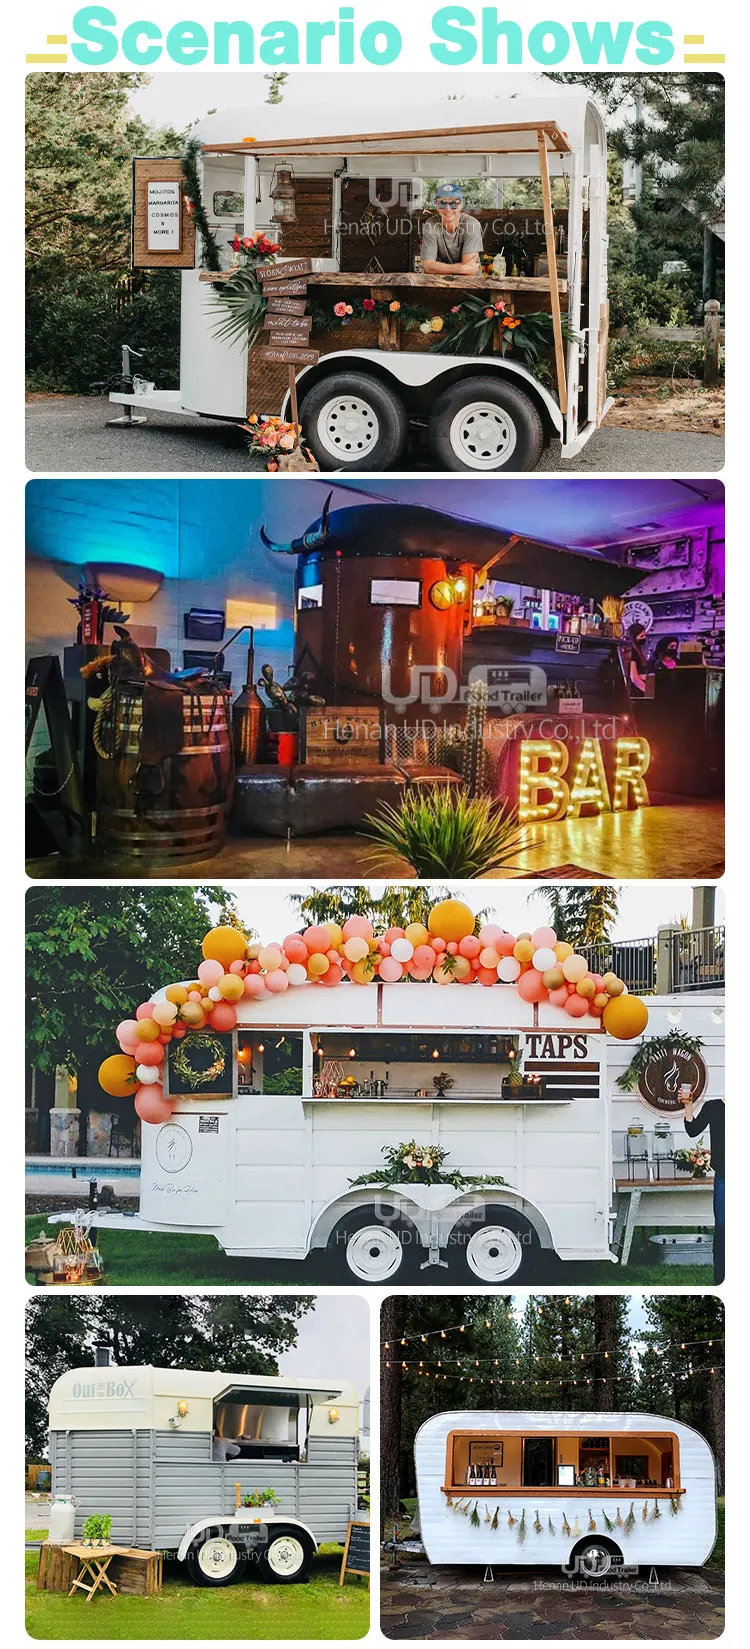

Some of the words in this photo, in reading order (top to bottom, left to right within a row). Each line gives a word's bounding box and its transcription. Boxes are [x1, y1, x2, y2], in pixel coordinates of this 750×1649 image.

[519, 736, 651, 823] BAR
[525, 1034, 588, 1059] TAPS
[672, 1047, 693, 1062] WAGON
[72, 1381, 96, 1399] Out
